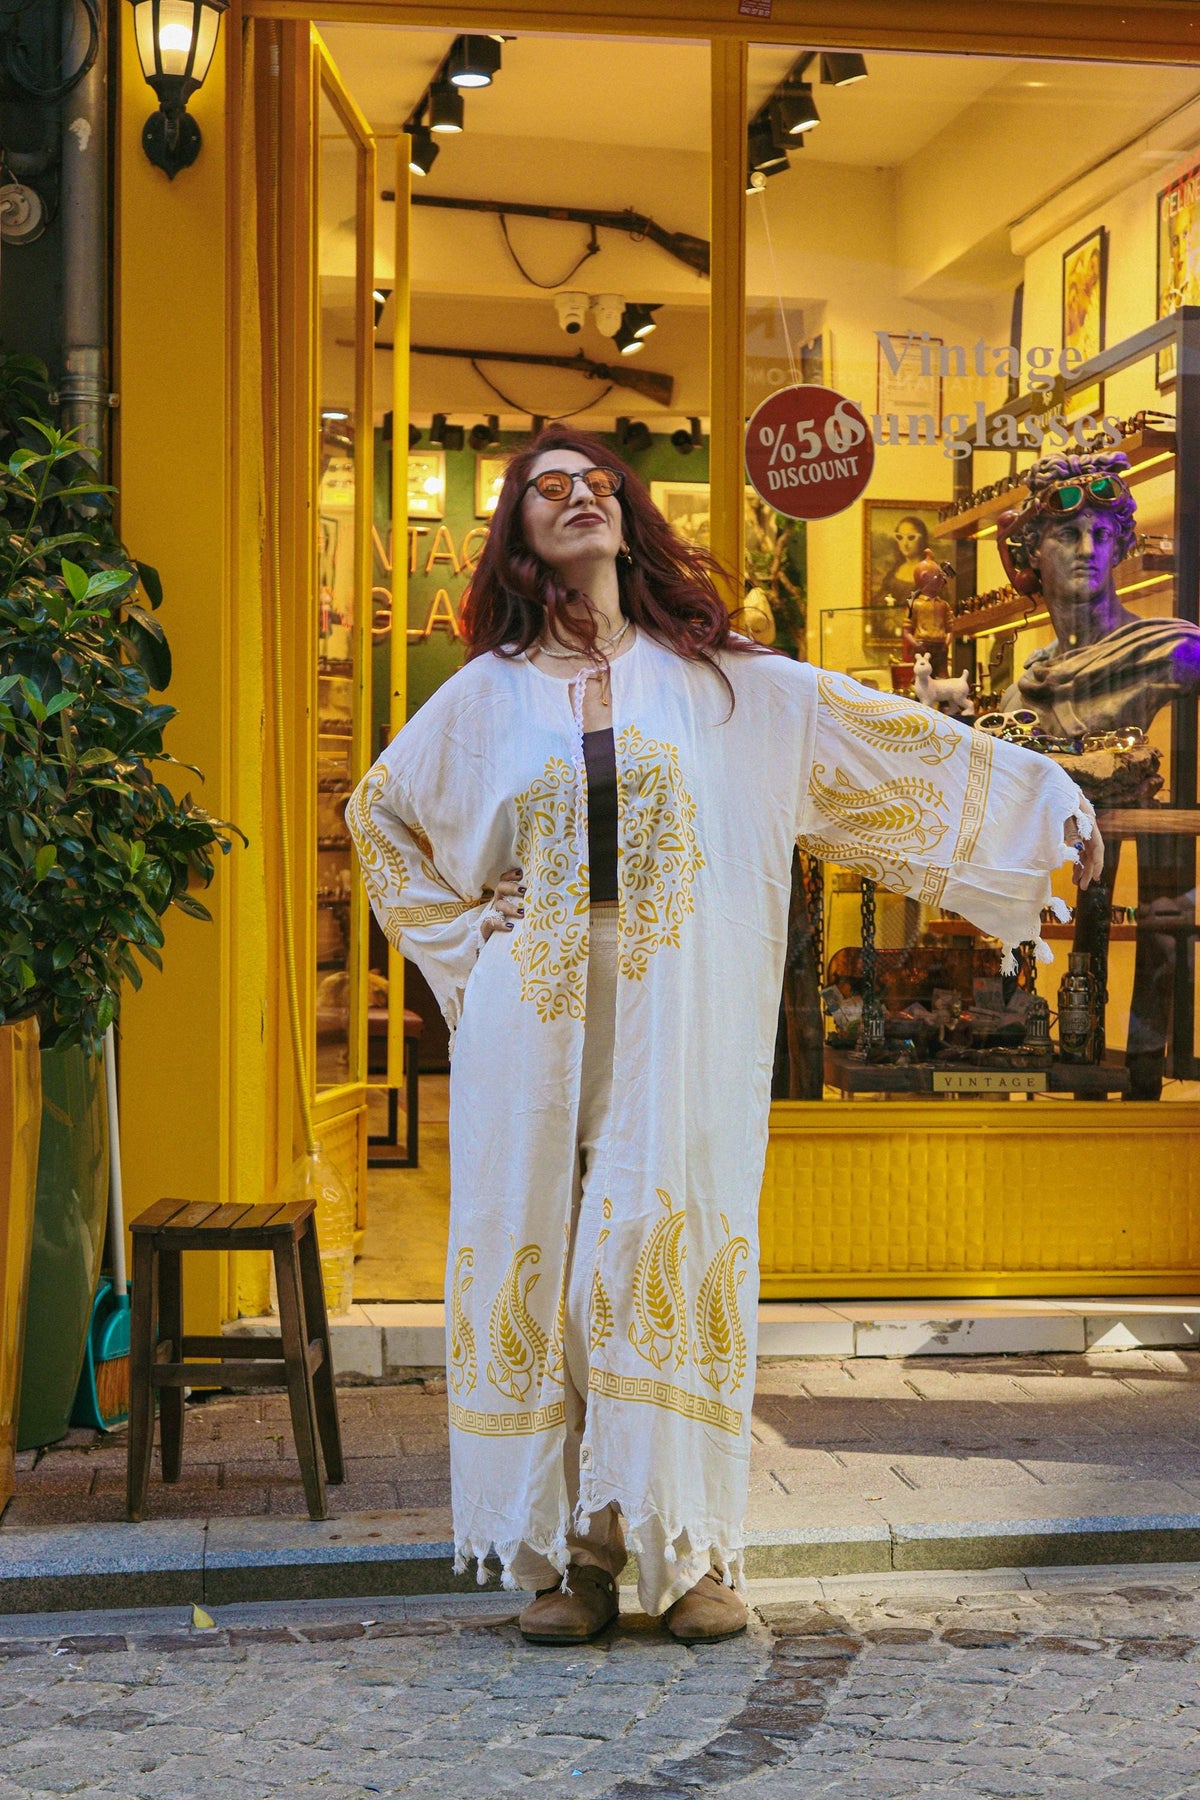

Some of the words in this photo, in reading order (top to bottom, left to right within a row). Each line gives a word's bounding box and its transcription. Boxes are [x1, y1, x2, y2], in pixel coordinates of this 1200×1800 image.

[874, 329, 1083, 393] Vintage
[759, 415, 853, 465] %50
[833, 399, 1123, 460] Sunglasses
[767, 456, 858, 490] DISCOUNT
[944, 1077, 1035, 1088] VINTAGE
